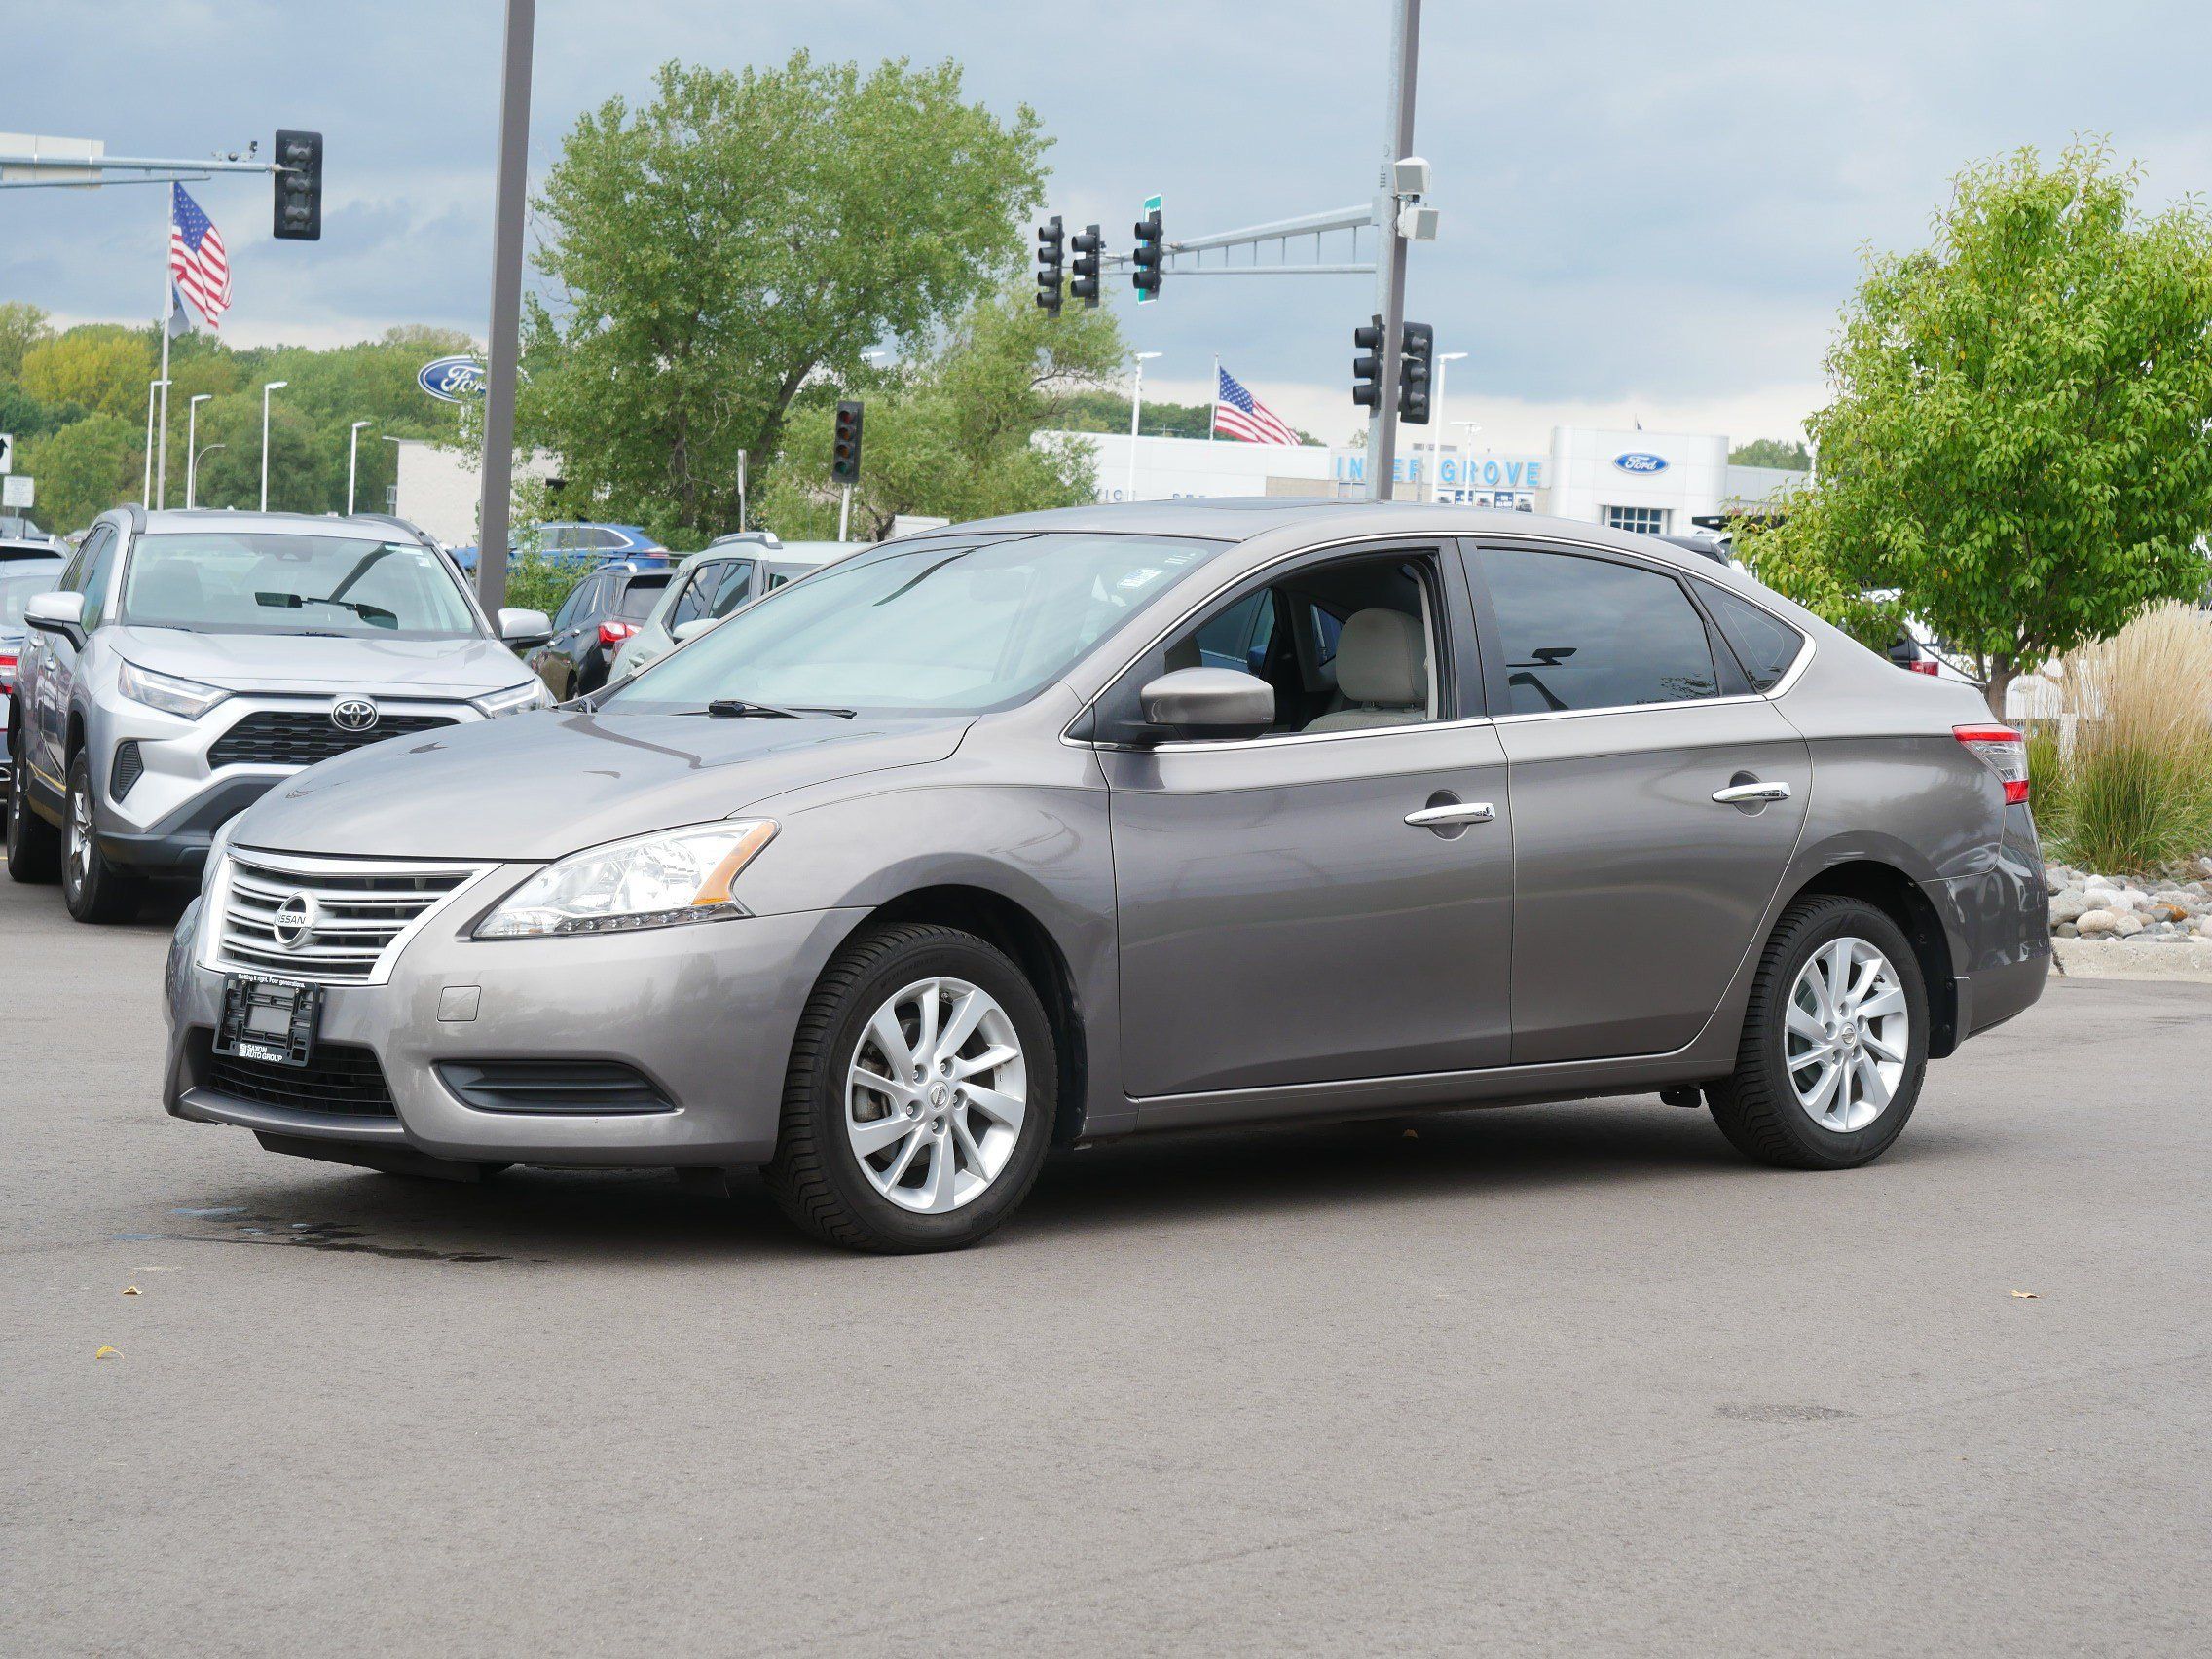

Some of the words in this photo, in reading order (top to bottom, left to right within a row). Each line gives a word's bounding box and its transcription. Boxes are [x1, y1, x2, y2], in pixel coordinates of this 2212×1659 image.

[440, 365, 488, 392] For
[1625, 455, 1658, 470] Ford
[1441, 458, 1542, 486] GROVE
[276, 914, 307, 924] NISSAN
[246, 1044, 268, 1053] SAXON
[245, 1051, 262, 1059] AUTO
[261, 1052, 283, 1063] GROUP
